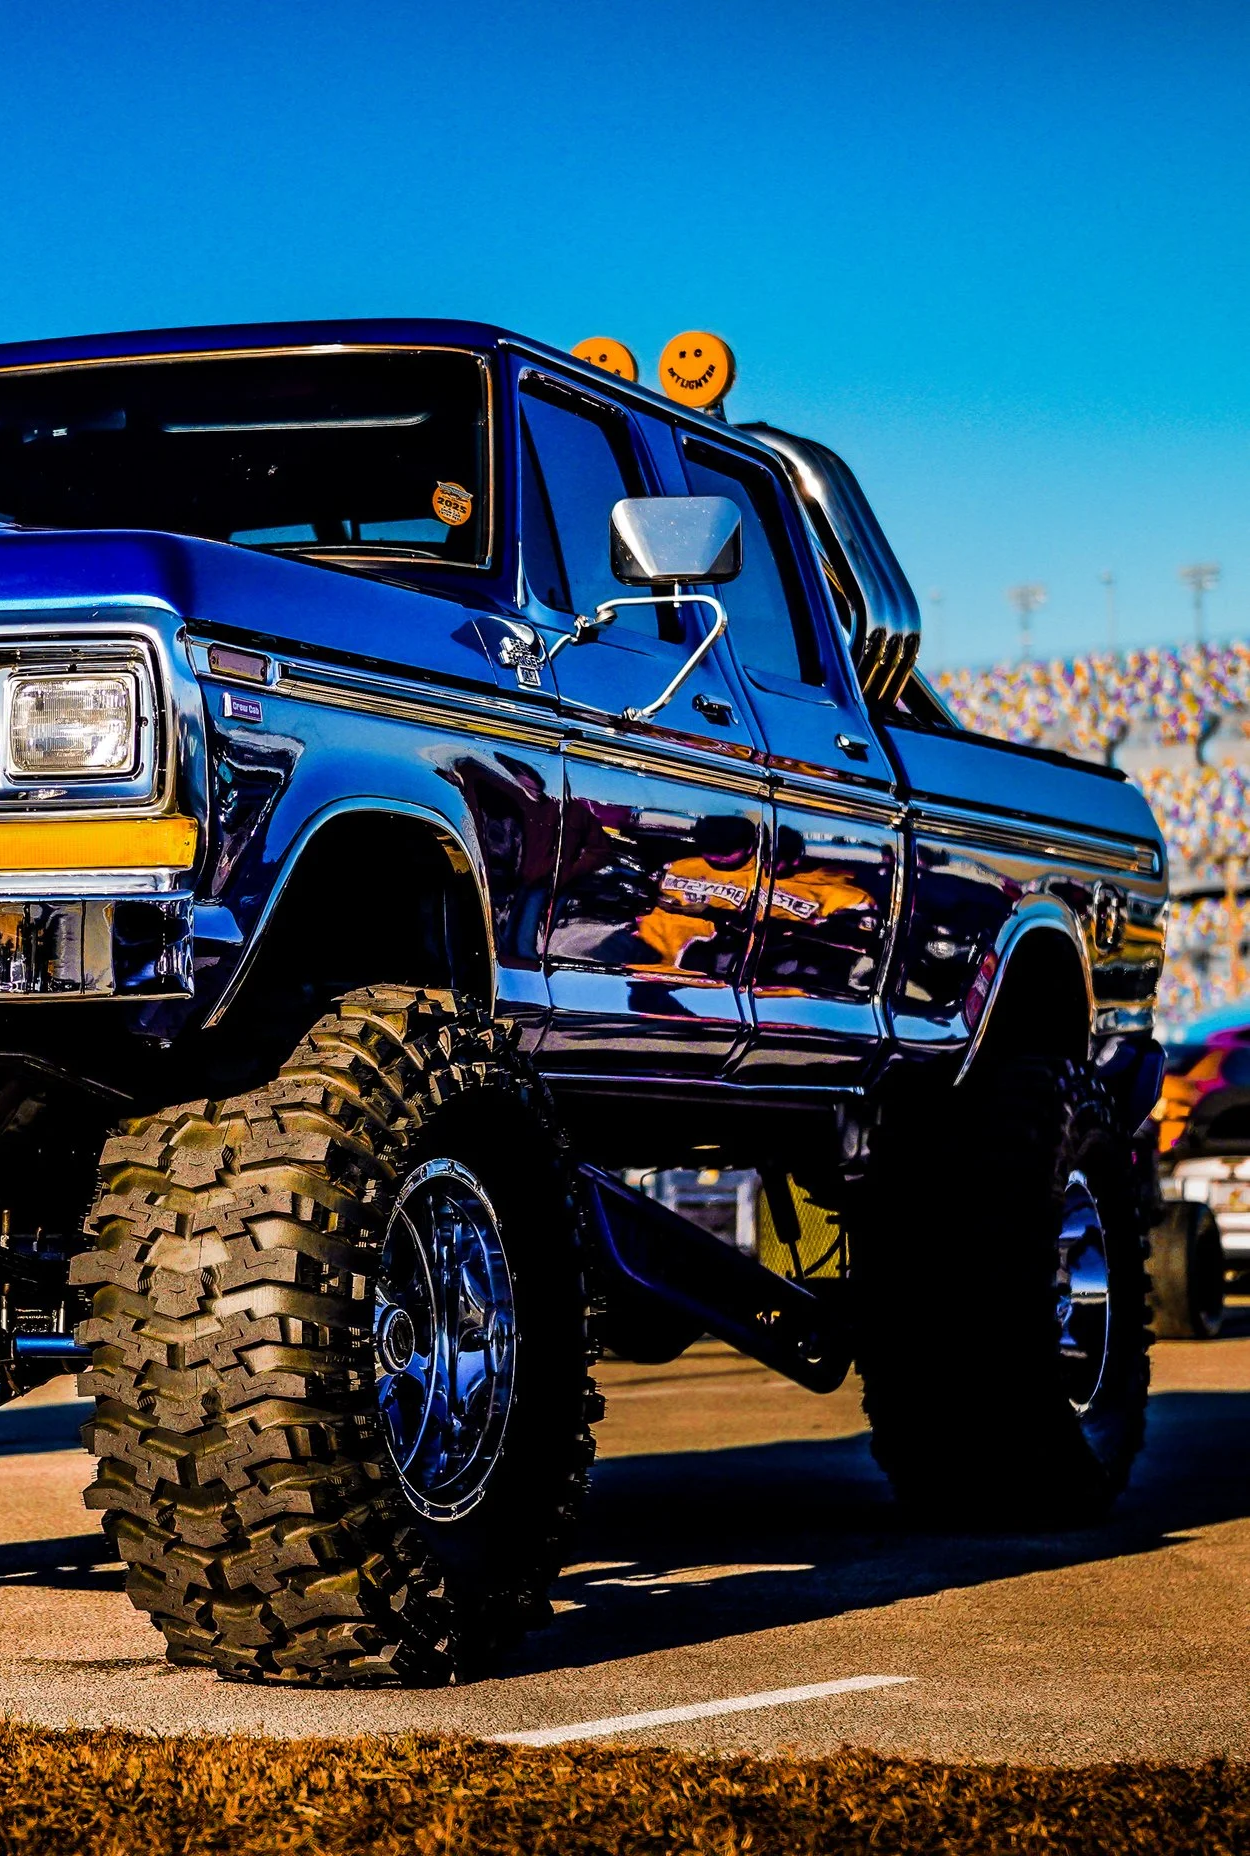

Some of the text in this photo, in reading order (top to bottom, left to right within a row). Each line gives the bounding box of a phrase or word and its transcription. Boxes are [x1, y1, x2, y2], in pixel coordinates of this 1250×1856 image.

[437, 496, 468, 514] 2025
[232, 701, 260, 715] Crew Cab
